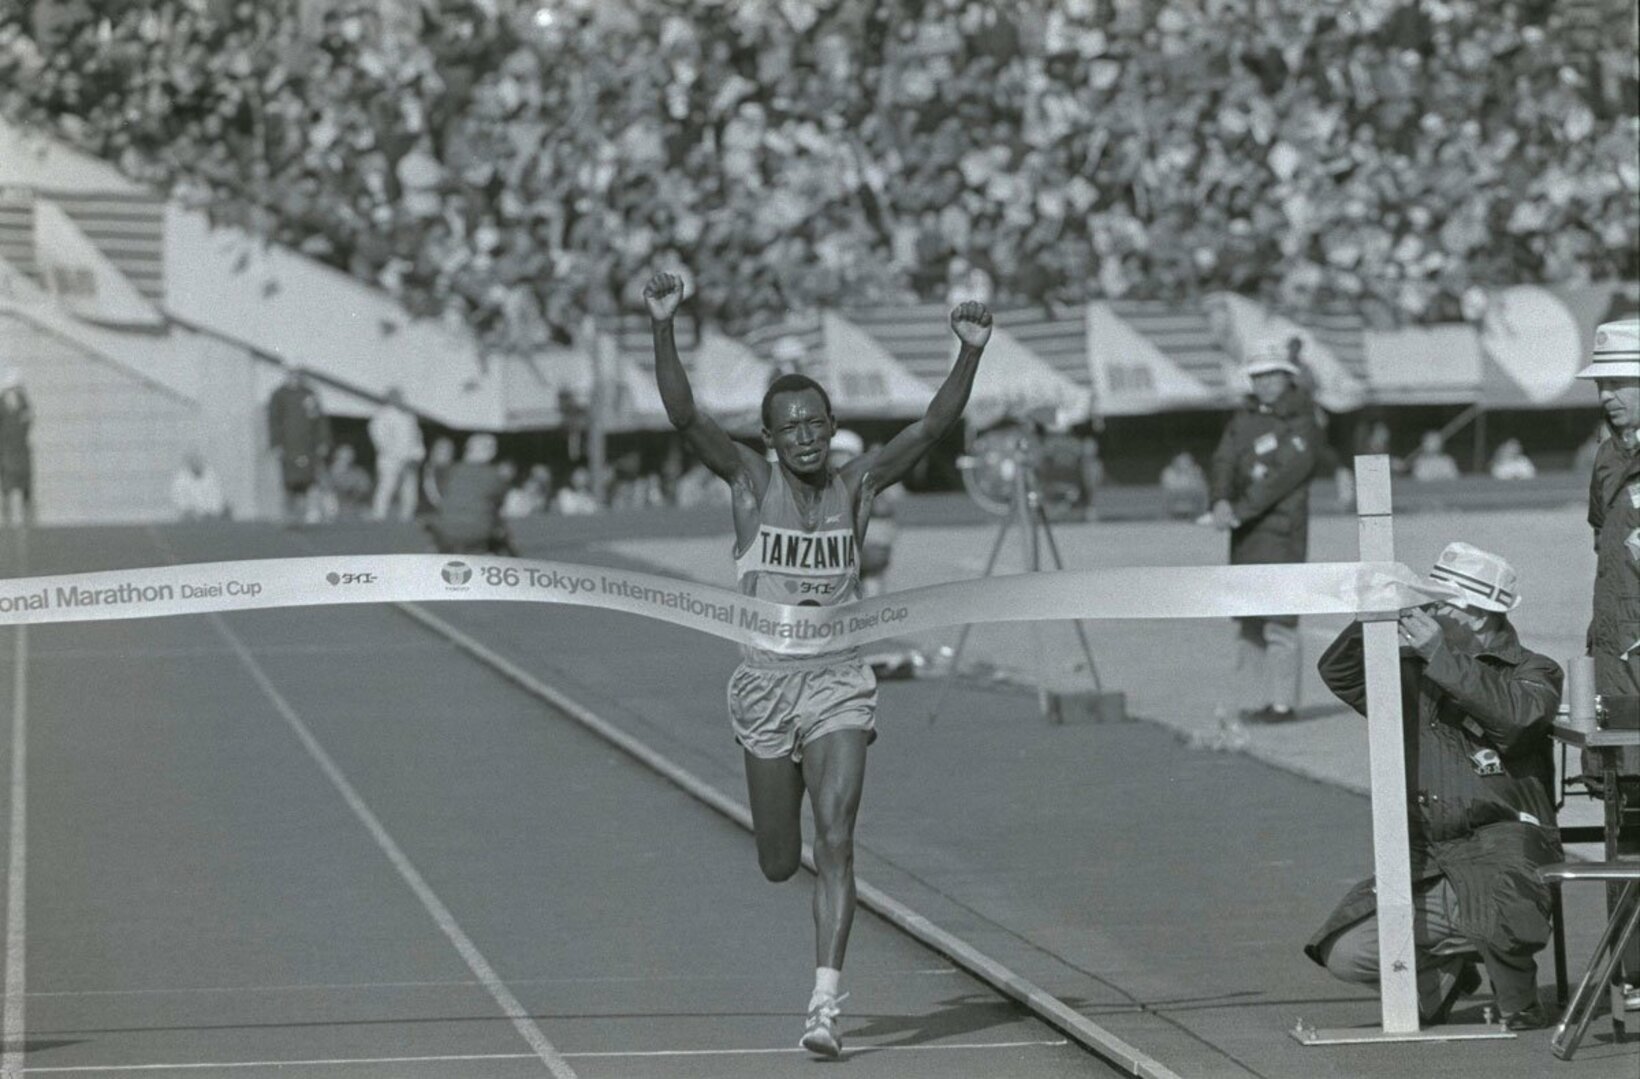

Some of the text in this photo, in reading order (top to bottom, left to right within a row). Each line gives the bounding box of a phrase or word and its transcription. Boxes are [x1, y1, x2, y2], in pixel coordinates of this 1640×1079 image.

[761, 531, 855, 568] TANZANIA
[56, 583, 174, 608] Marathon
[181, 583, 222, 599] Daiei
[226, 580, 262, 597] Cup
[524, 567, 596, 594] Tokyo
[601, 576, 735, 625] International
[739, 607, 844, 640] Marathon
[848, 613, 879, 633] Daiei
[881, 606, 908, 624] Cup
